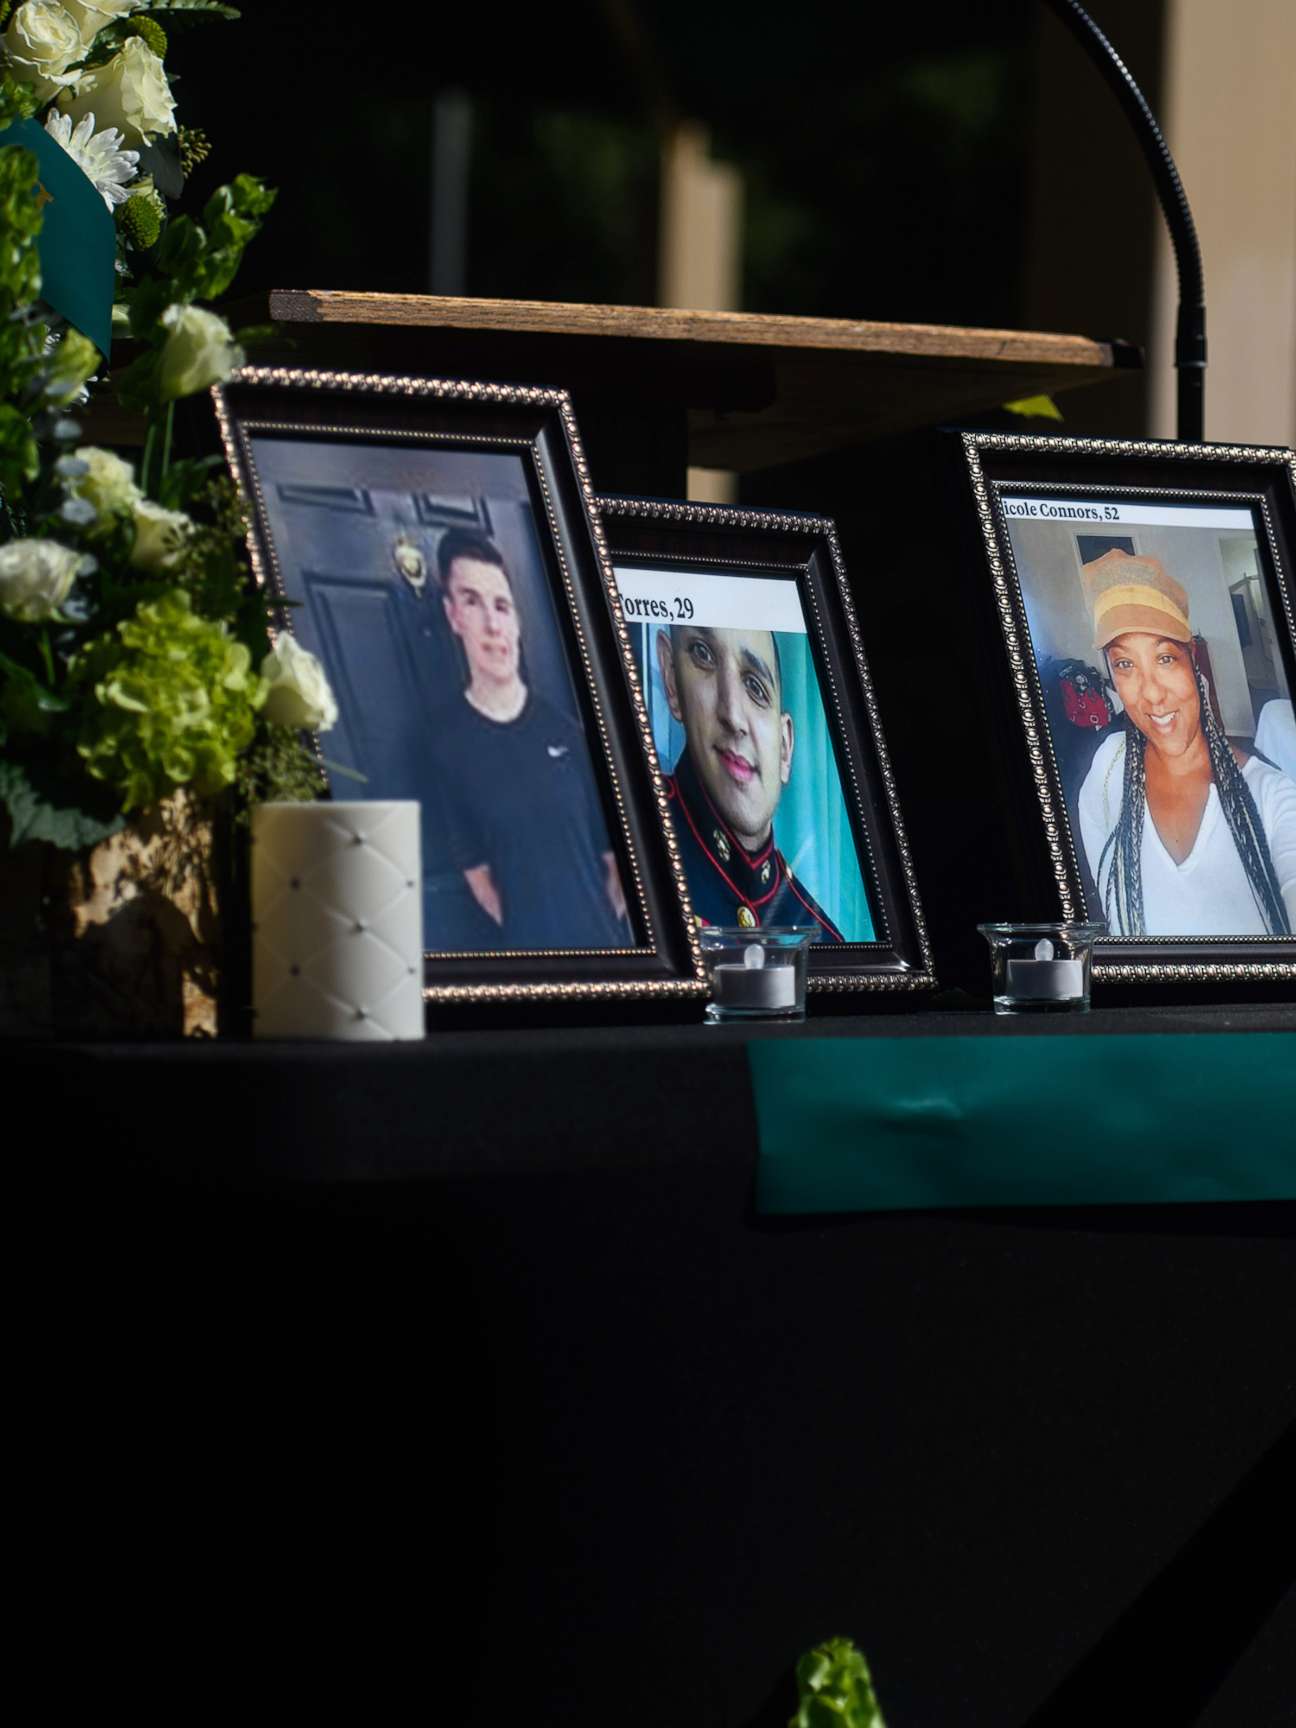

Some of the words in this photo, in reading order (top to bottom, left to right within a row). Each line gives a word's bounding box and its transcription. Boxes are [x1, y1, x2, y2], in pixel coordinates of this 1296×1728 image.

[1003, 501, 1038, 516] icole
[1040, 503, 1103, 521] Connors,
[1104, 506, 1120, 520] 52
